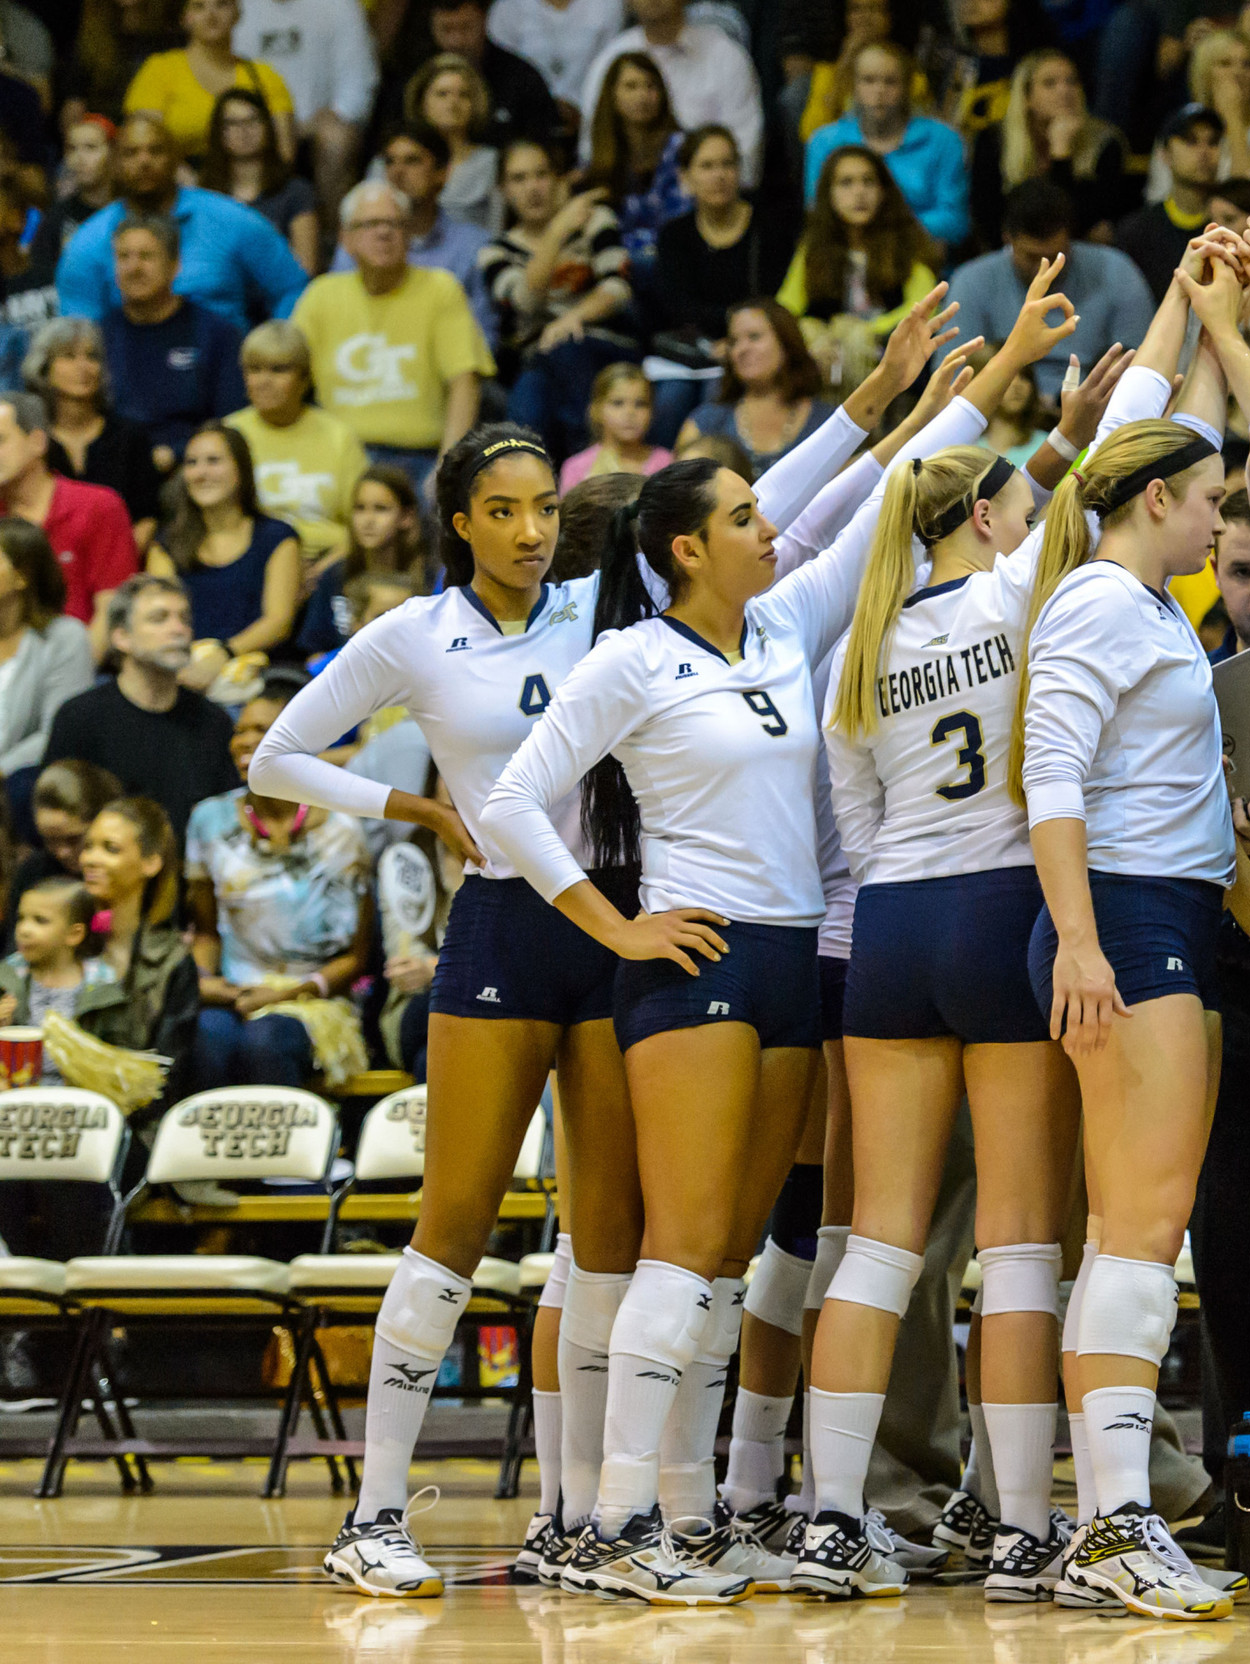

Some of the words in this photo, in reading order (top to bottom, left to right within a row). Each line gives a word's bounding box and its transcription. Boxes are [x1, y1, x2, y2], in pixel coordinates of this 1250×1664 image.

[960, 633, 1016, 688] TECH
[516, 671, 553, 718] 4
[742, 690, 788, 738] 9
[930, 707, 989, 802] 3
[0, 1104, 109, 1131] EORGIA
[178, 1101, 319, 1128] GEORGIA
[202, 1128, 292, 1158] TECH
